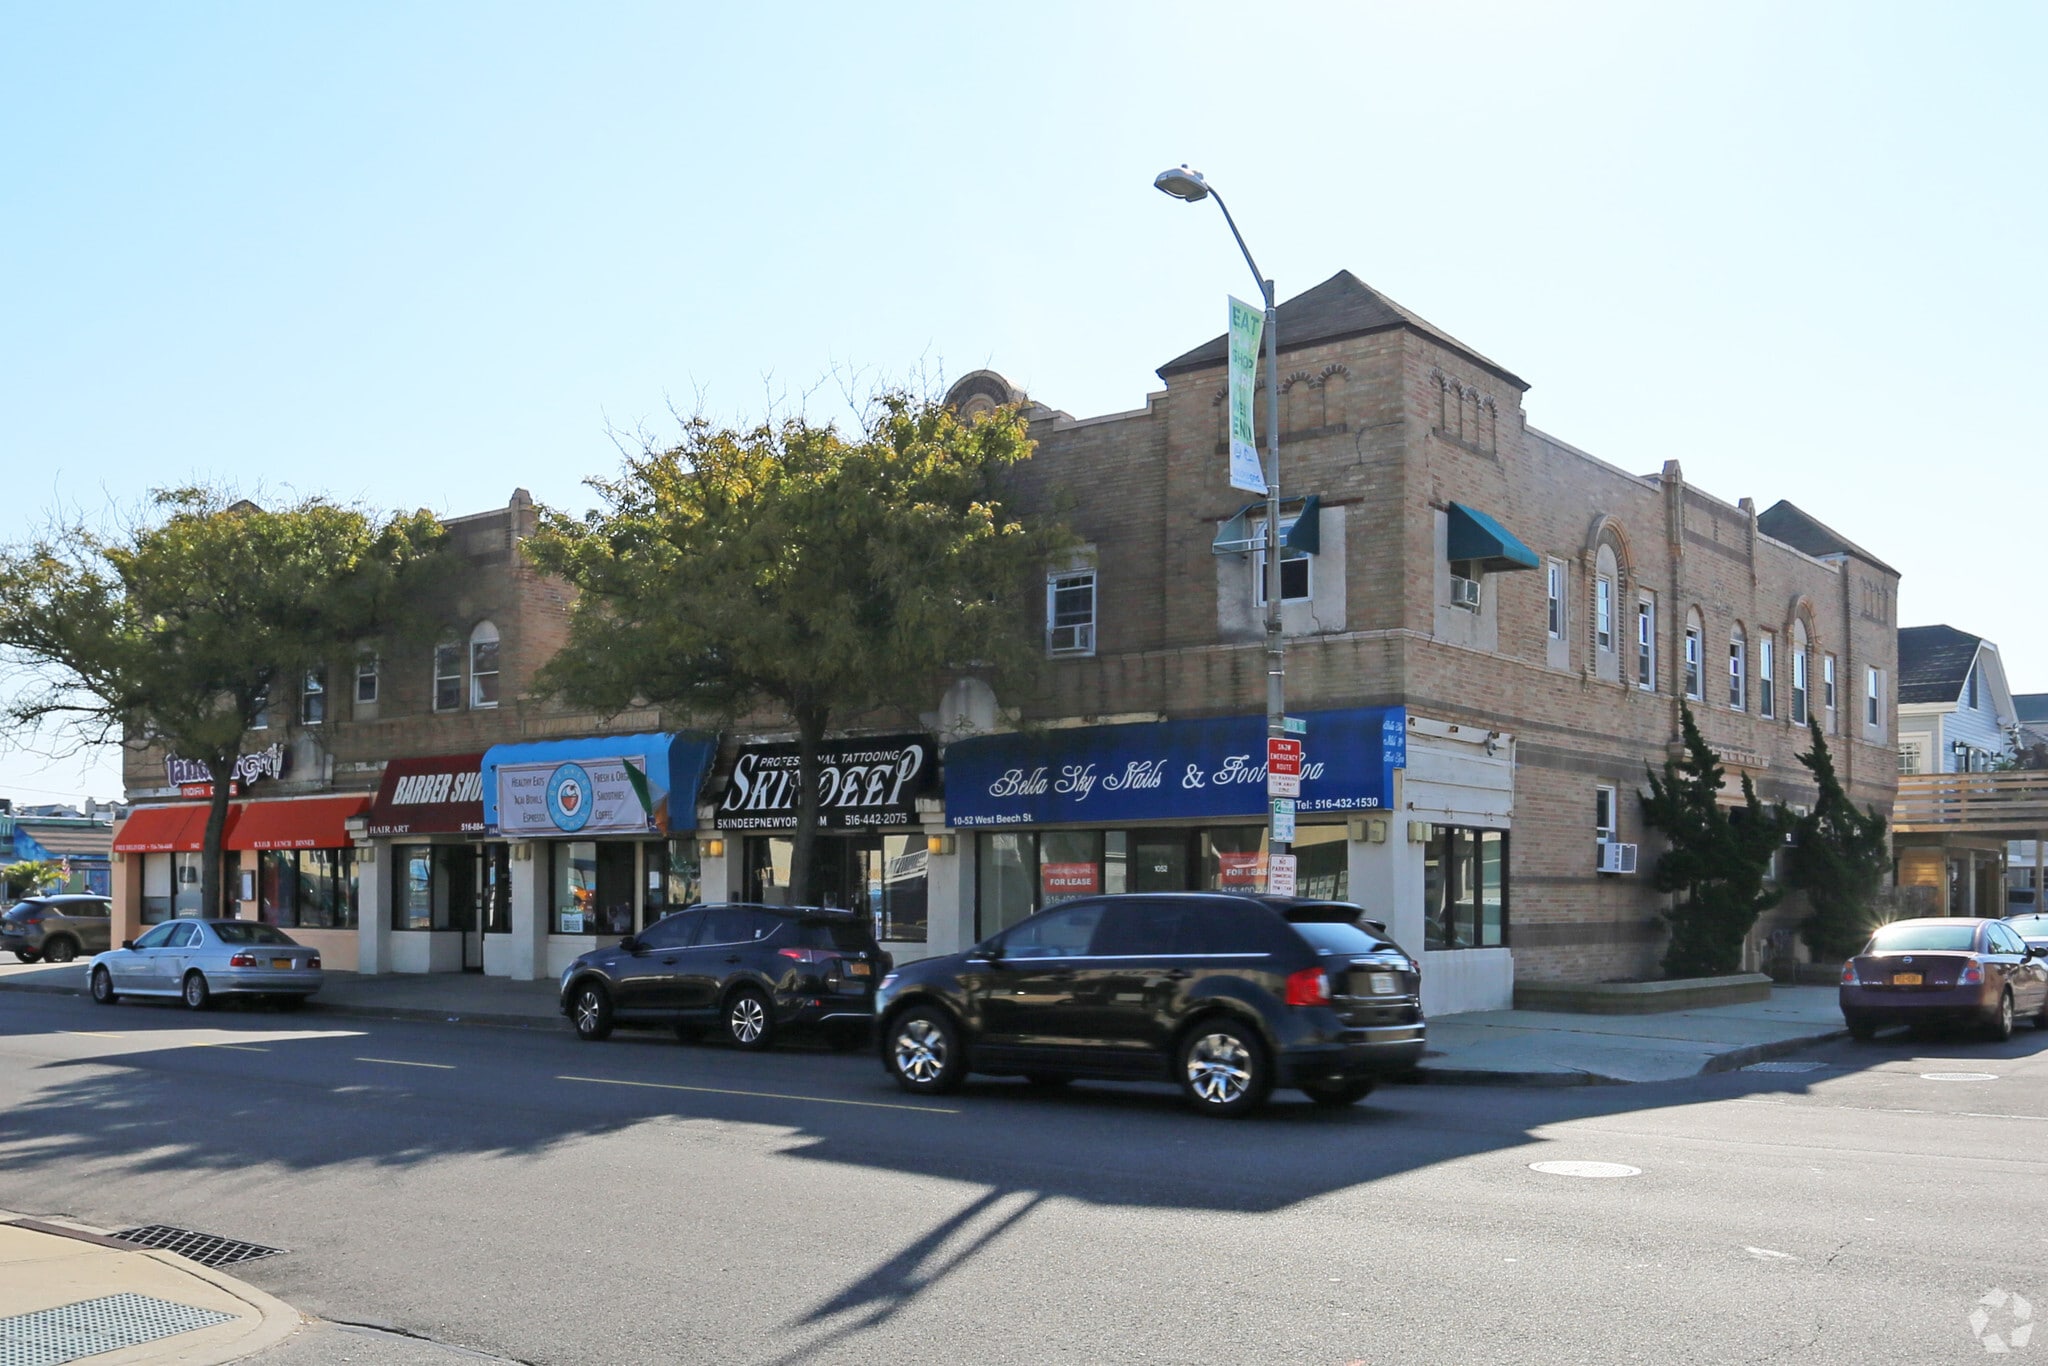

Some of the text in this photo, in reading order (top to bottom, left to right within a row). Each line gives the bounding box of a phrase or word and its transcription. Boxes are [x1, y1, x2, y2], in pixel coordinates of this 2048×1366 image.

[1233, 306, 1259, 335] EAT
[1278, 743, 1291, 751] SNOW
[842, 750, 899, 764] TATTOOING
[1270, 753, 1298, 761] EMERGENCY
[1276, 763, 1292, 771] ROUTE
[818, 744, 923, 807] DEEP
[989, 766, 1048, 797] Bella
[1054, 763, 1096, 802] Sky
[1102, 759, 1168, 790] Nails
[1182, 764, 1205, 789] &
[1212, 754, 1268, 785] Foot
[391, 772, 483, 805] BARBER SHO
[596, 790, 625, 801] SMOOTHIES
[1296, 800, 1312, 810] Tel:
[1315, 797, 1378, 809] 516-432-1530
[523, 813, 545, 823] ESPRESSO
[595, 809, 614, 820] COFFEE
[845, 813, 907, 826] 516-442-2075
[953, 813, 1033, 825] 10-52 West Beech St.
[370, 826, 391, 834] HAIR
[1226, 868, 1267, 876] FOR LEAS
[1050, 877, 1092, 886] FOR LEASE
